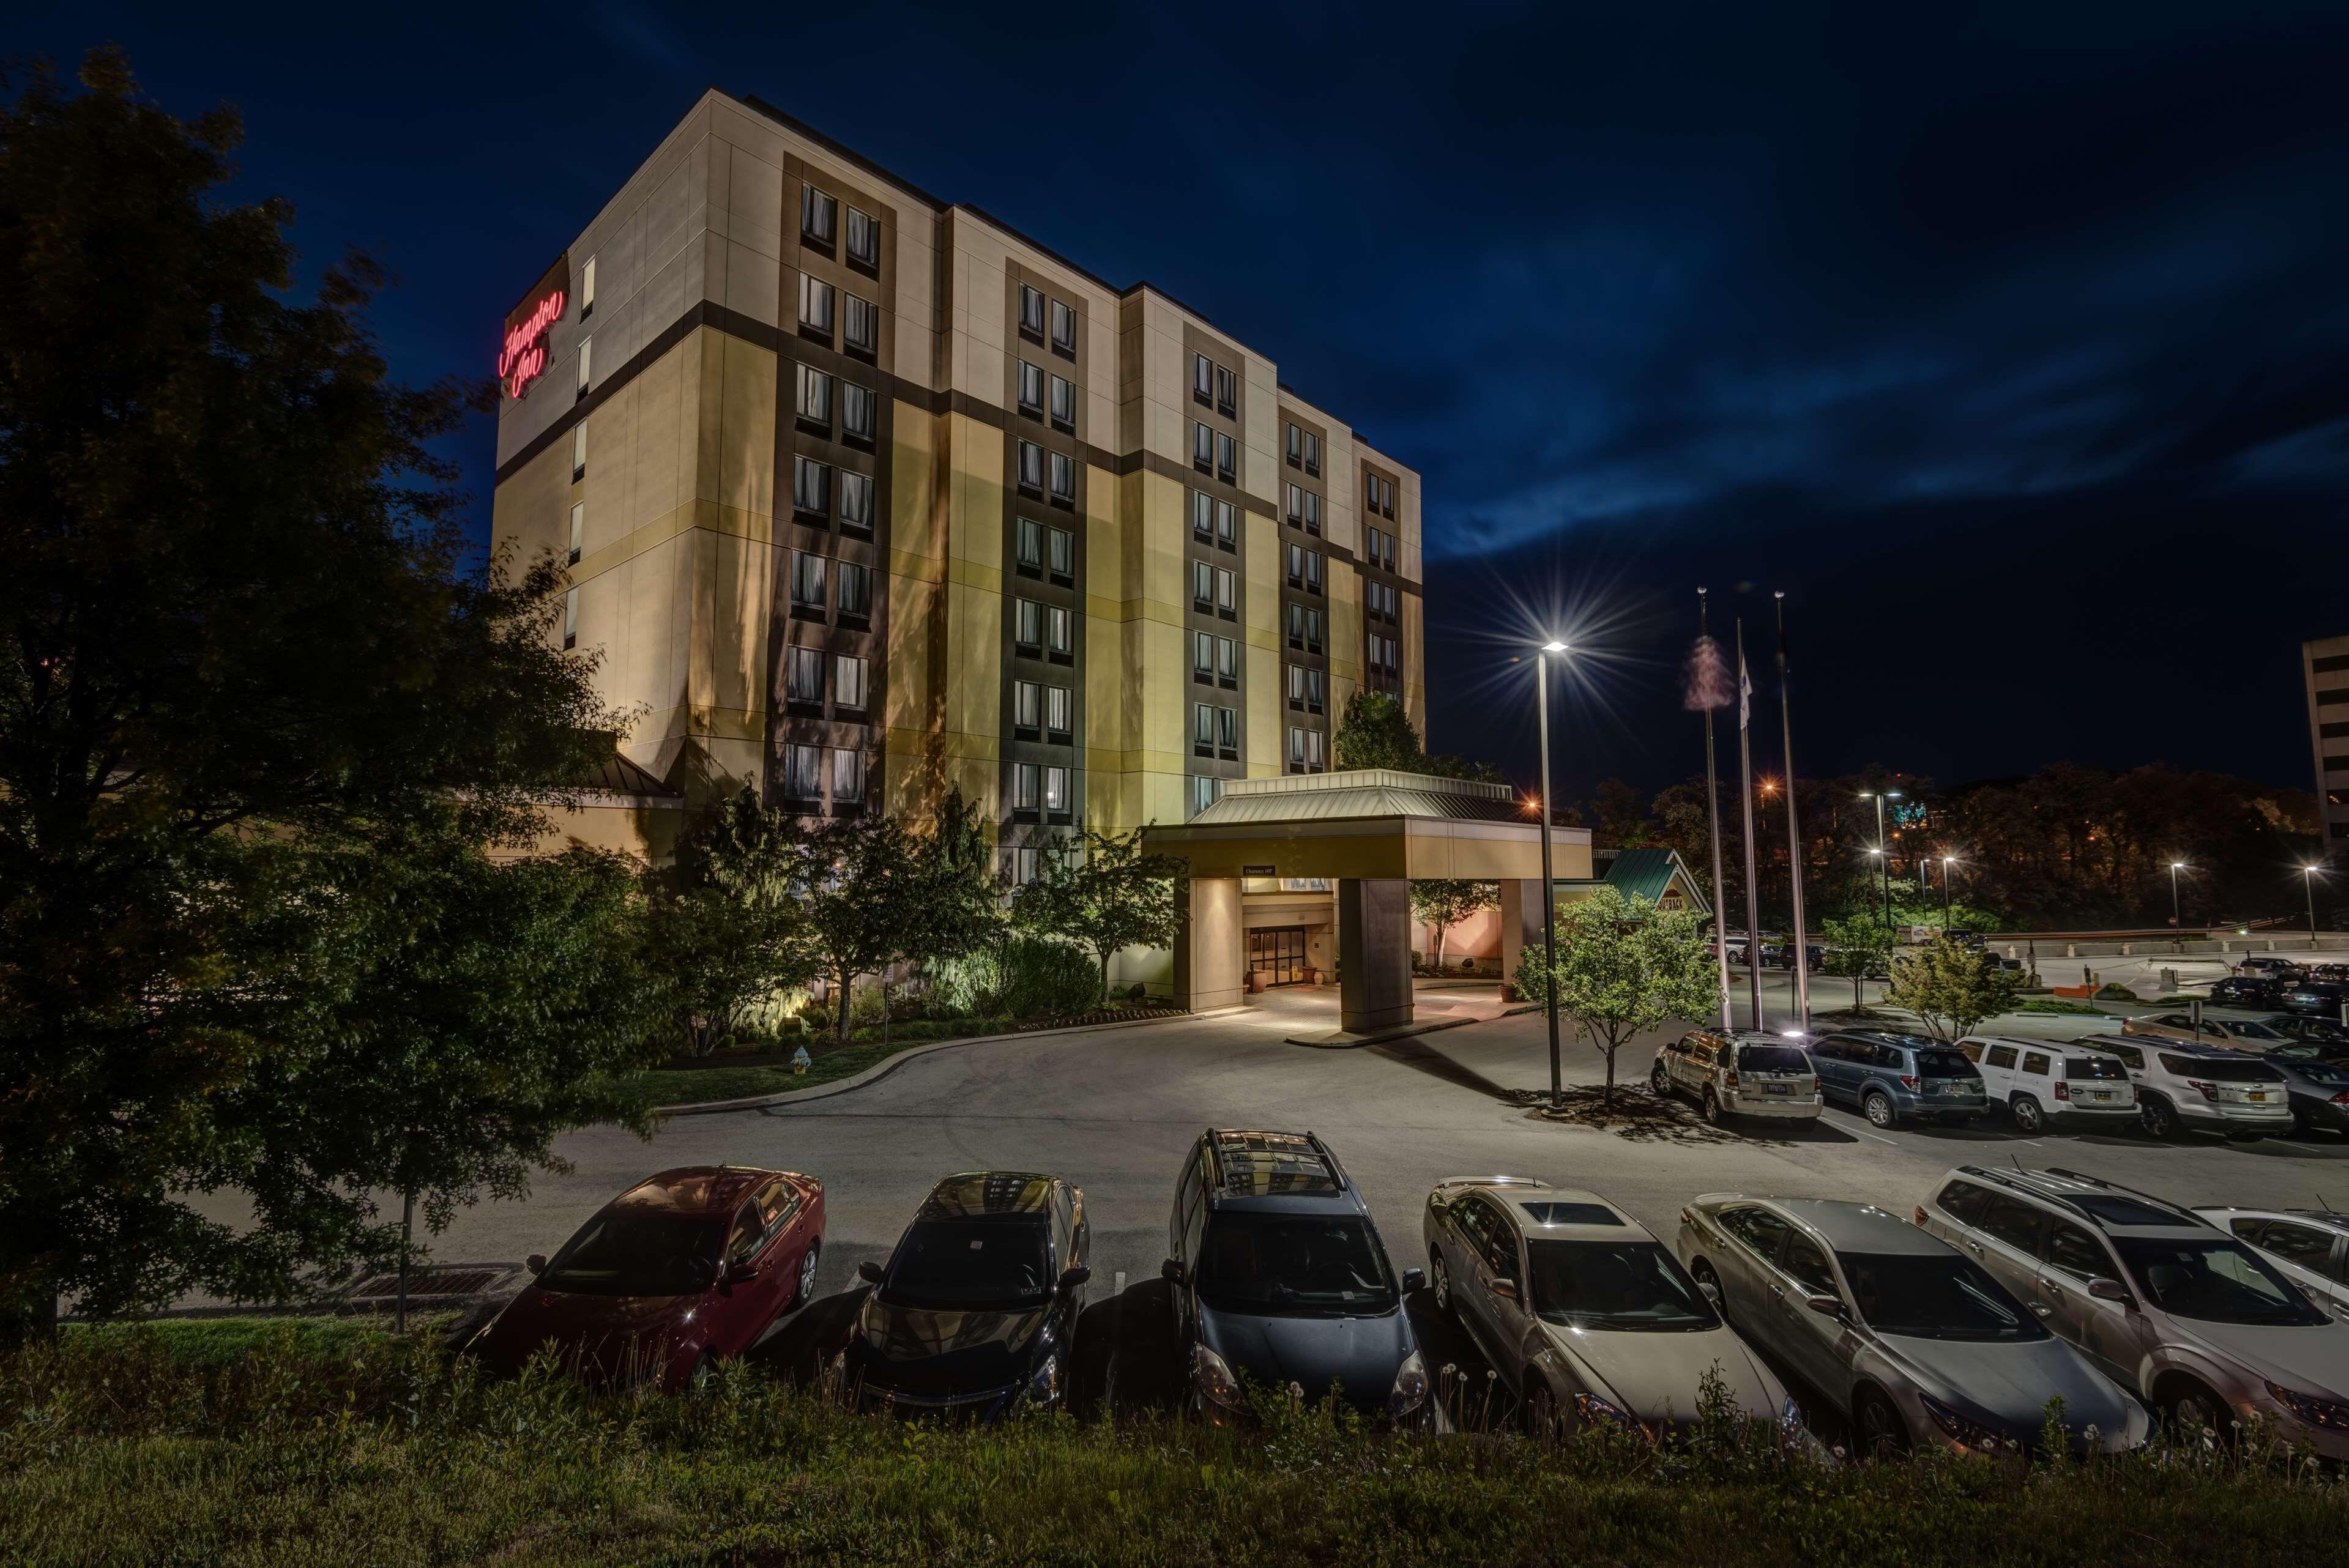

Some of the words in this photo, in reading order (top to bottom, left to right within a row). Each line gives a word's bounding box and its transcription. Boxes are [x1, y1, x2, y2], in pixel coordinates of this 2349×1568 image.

[499, 291, 562, 377] Hampton
[513, 347, 543, 398] Inn
[1658, 898, 1683, 911] OUTBACK
